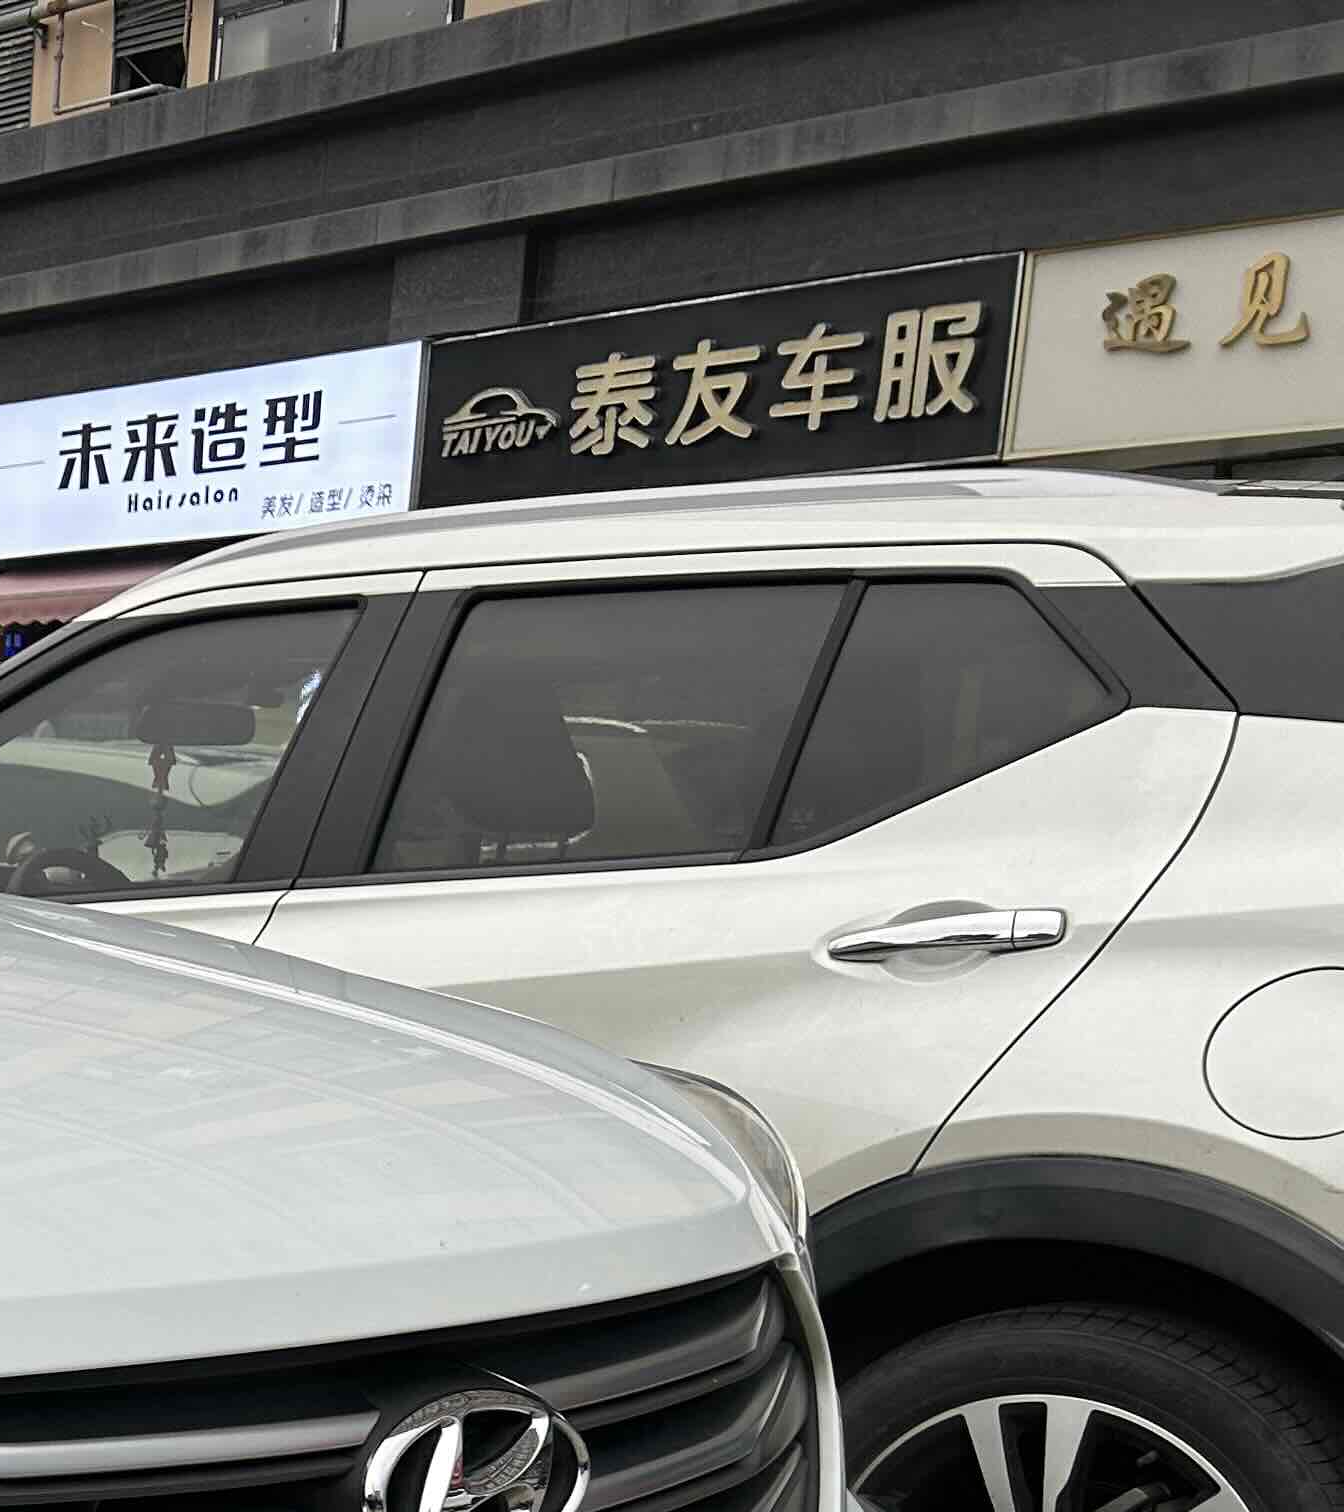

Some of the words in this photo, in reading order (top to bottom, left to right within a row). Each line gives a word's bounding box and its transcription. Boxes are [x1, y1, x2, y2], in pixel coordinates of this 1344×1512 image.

[1102, 250, 1311, 354] 遇见
[569, 300, 983, 457] 泰友车服
[57, 389, 324, 490] 未来造型
[441, 419, 535, 457] TAIYOU
